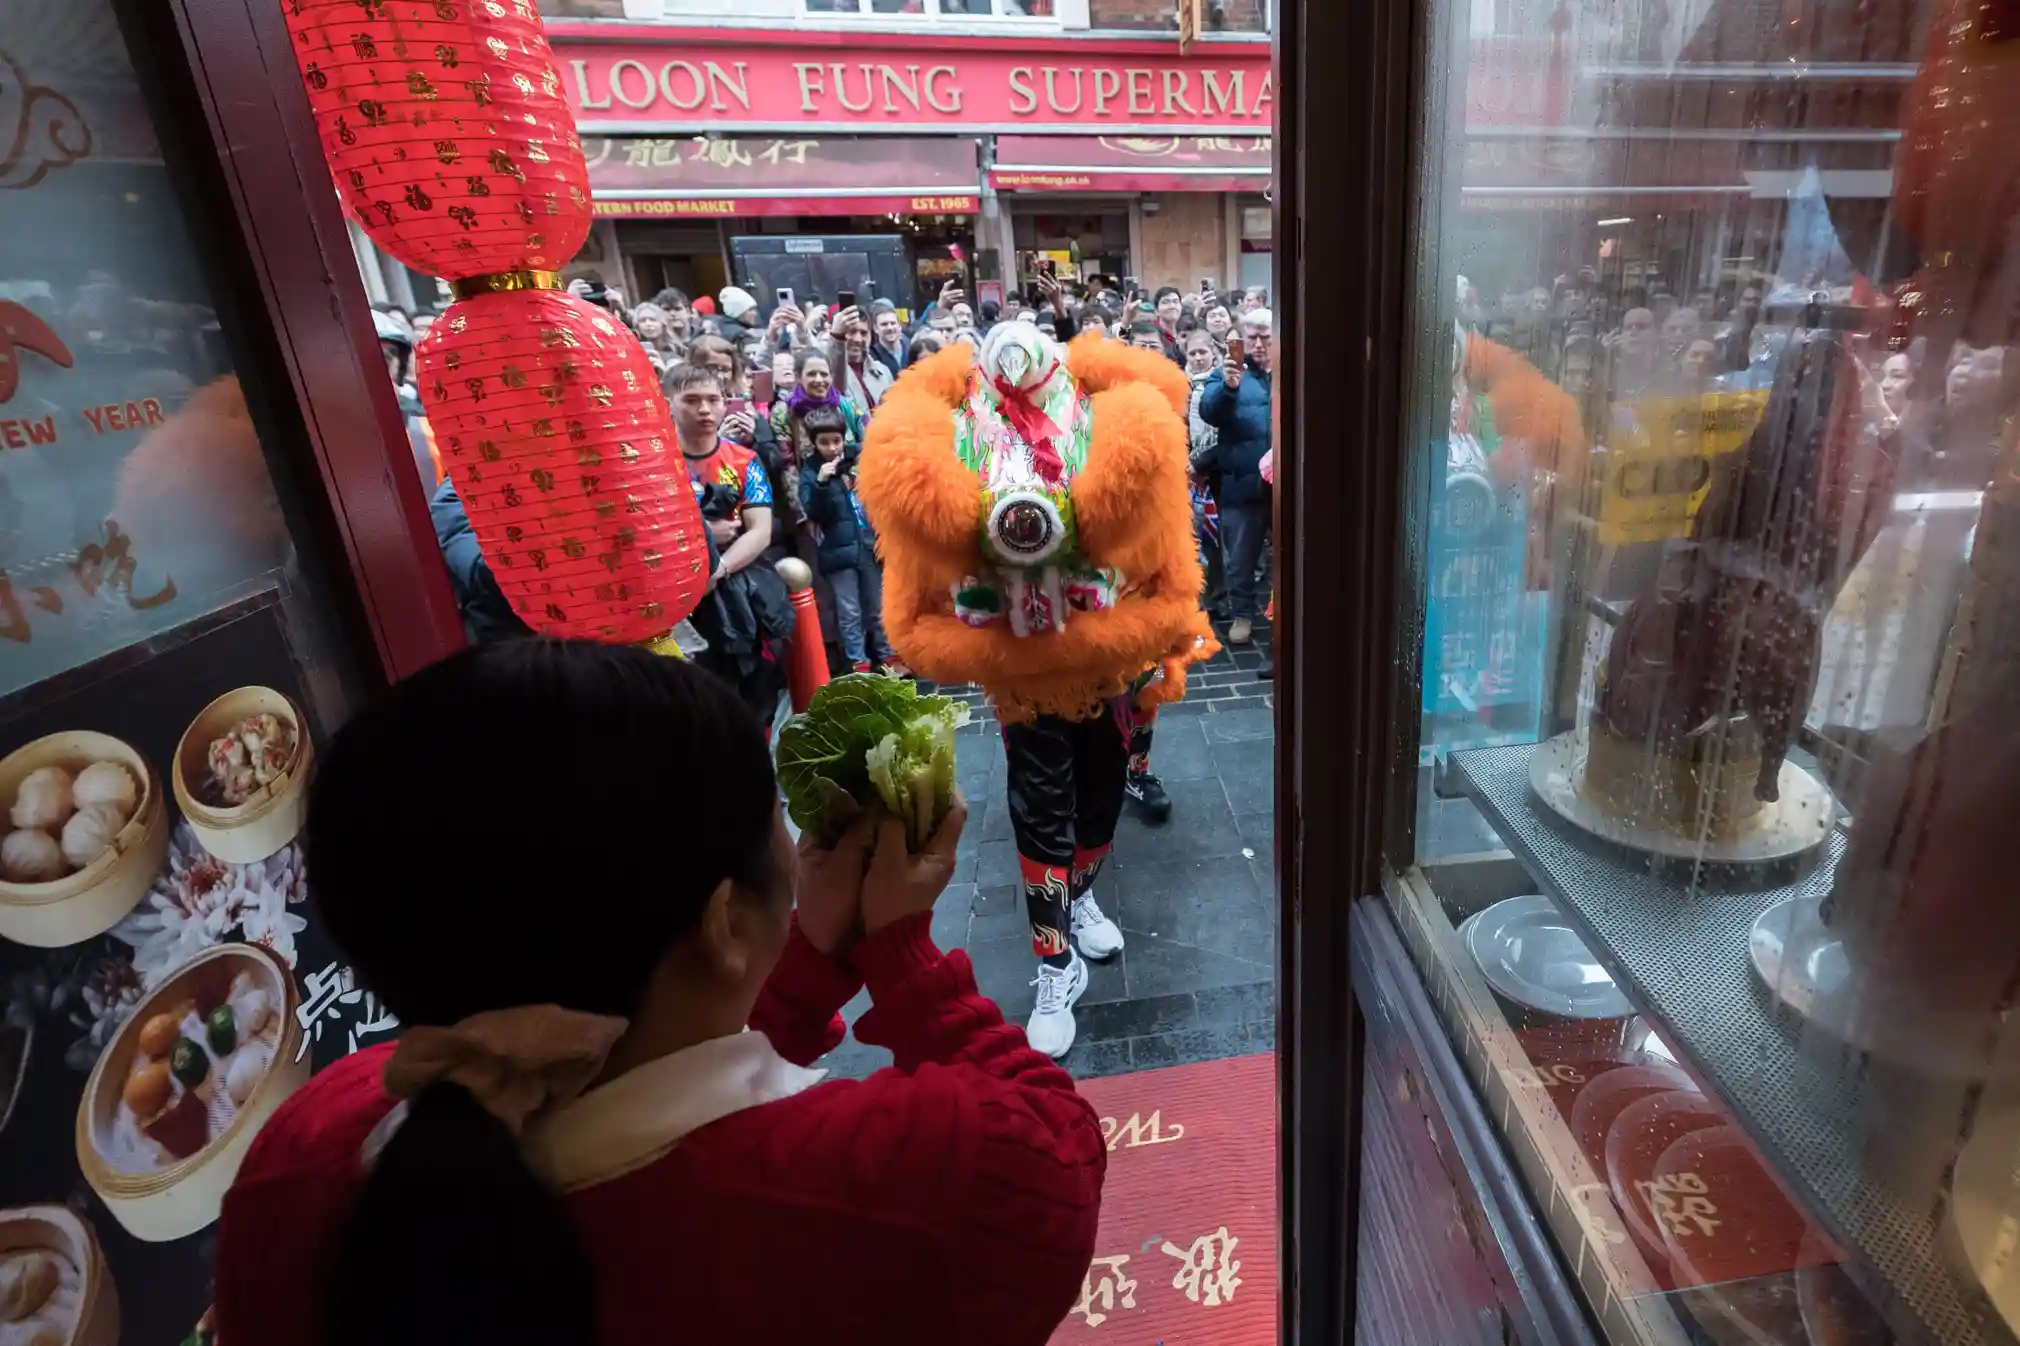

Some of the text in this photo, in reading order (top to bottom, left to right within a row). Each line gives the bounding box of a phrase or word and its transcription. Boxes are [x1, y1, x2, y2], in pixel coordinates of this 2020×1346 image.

[568, 59, 750, 111] LOON
[793, 62, 963, 113] FUNG
[634, 201, 675, 213] FOOD
[677, 200, 735, 213] MARKET
[0, 397, 165, 450] EW YEAR
